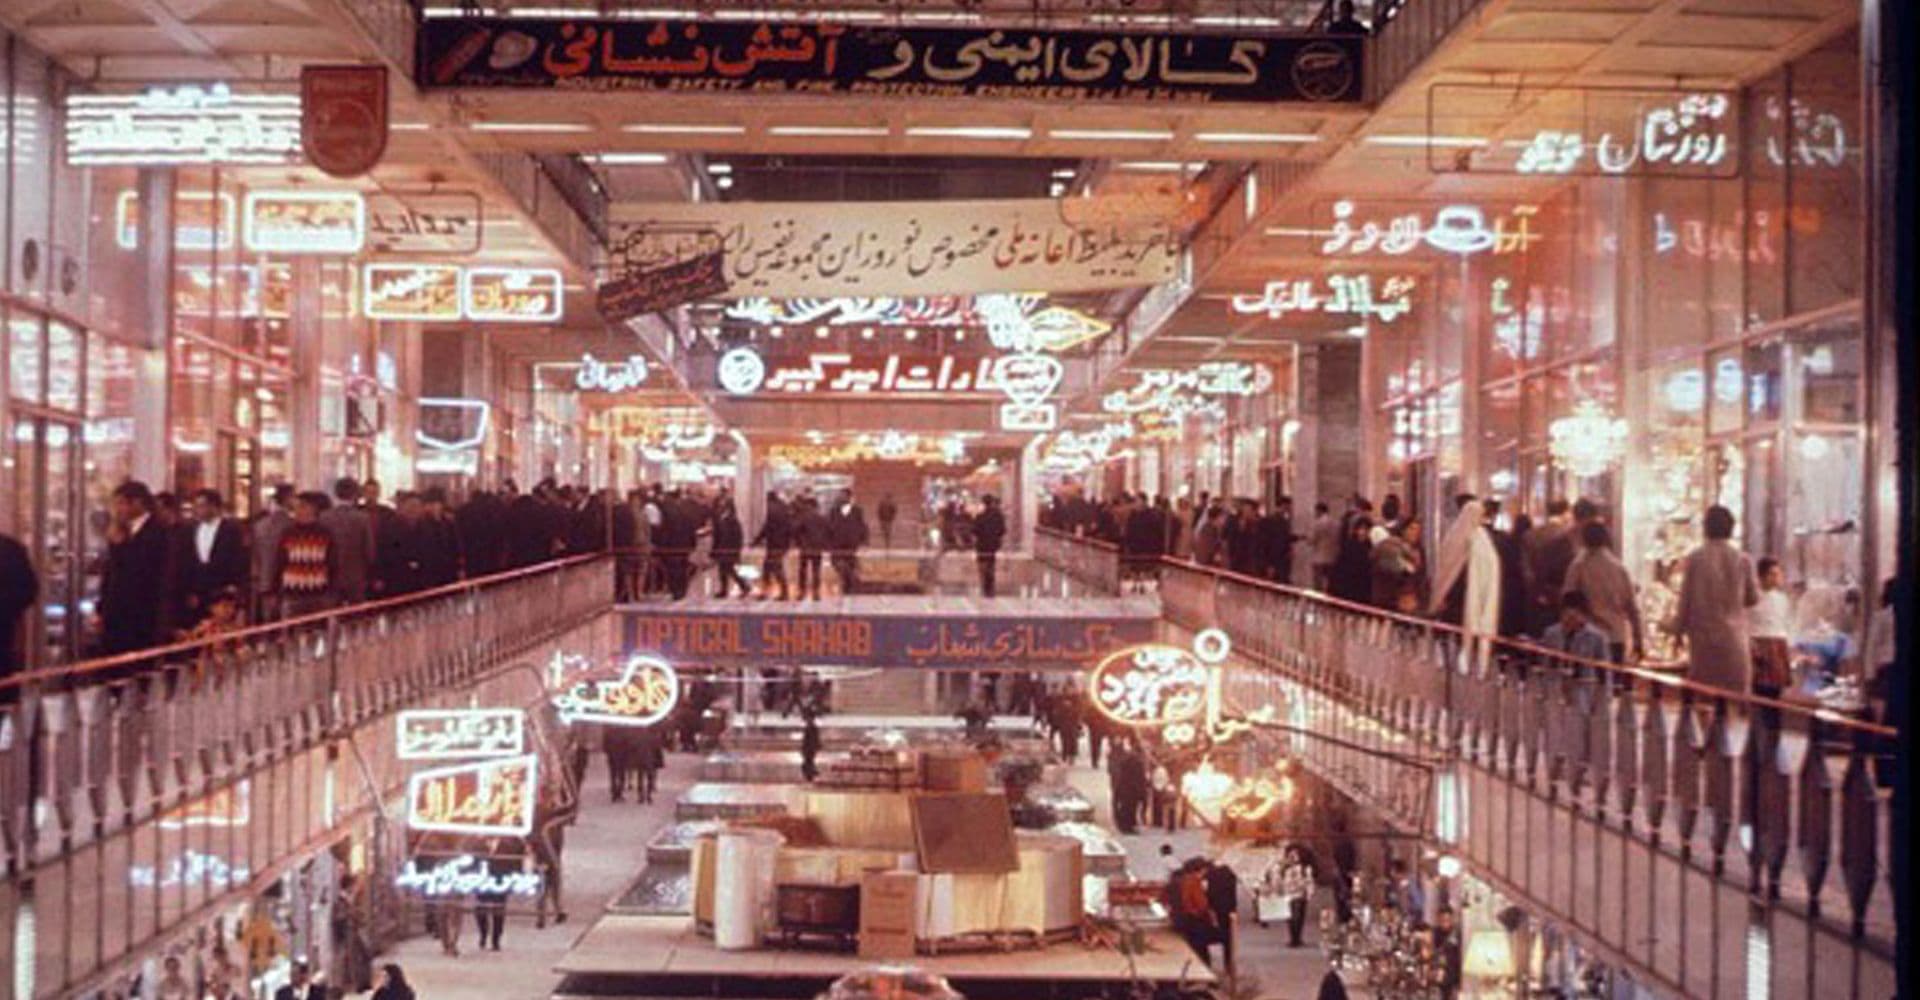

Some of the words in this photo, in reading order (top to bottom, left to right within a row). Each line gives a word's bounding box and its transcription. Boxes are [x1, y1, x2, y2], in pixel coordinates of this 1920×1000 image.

[543, 20, 708, 76] نشانی
[712, 22, 845, 75] آتش
[866, 40, 914, 79] و
[923, 31, 1055, 82] ایمنی
[907, 224, 999, 276] مخصوص
[766, 353, 851, 391] کبیر
[831, 355, 898, 391] امیر
[637, 617, 748, 654] OPTICAL
[762, 619, 872, 657] SHAHAB
